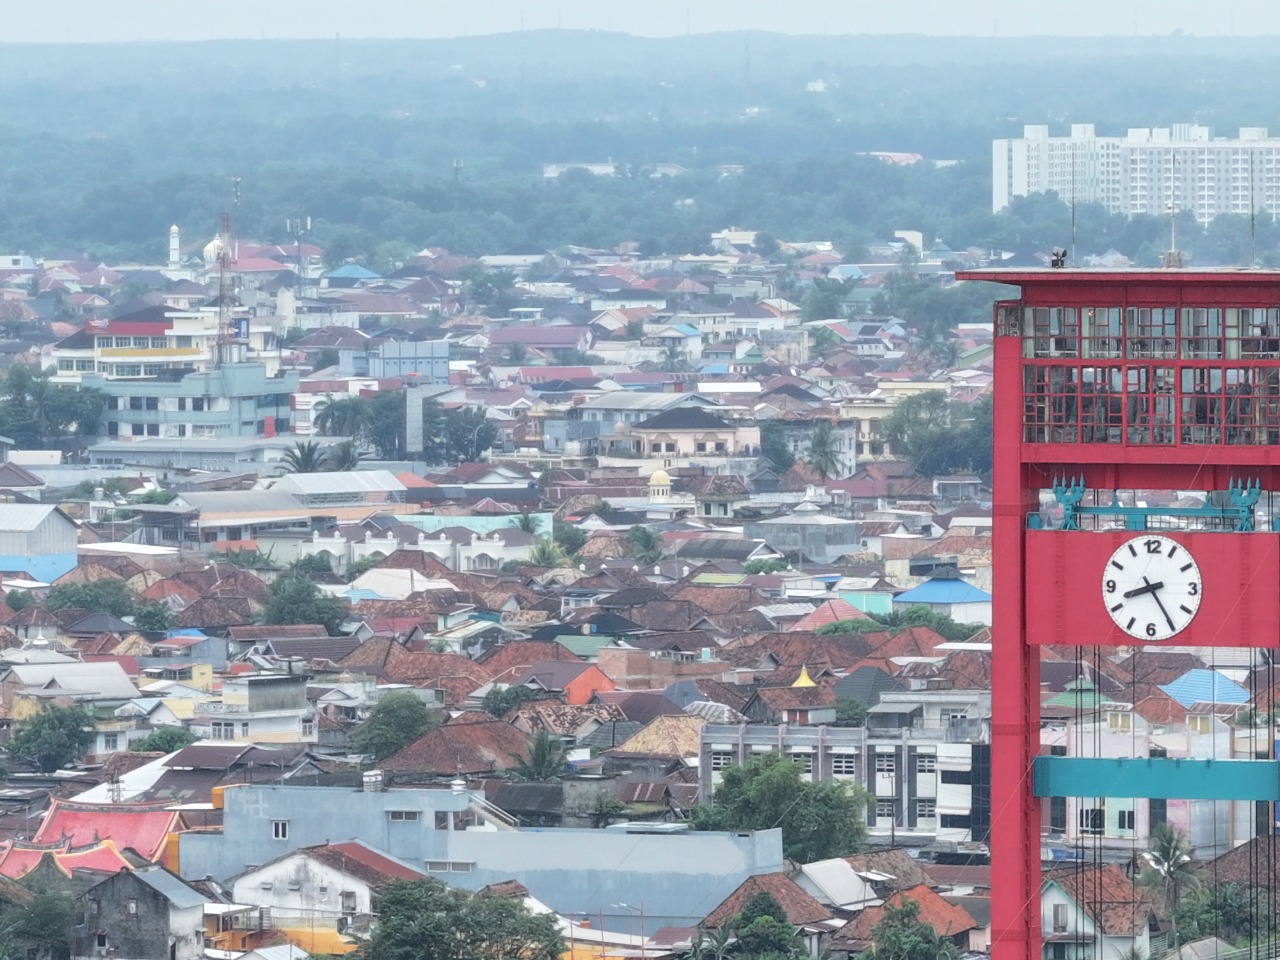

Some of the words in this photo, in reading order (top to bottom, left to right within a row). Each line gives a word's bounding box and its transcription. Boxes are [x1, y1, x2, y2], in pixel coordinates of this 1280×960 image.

[1143, 539, 1162, 555] 12
[1106, 579, 1116, 594] 9
[1187, 581, 1199, 596] 3
[1145, 622, 1157, 637] 6
